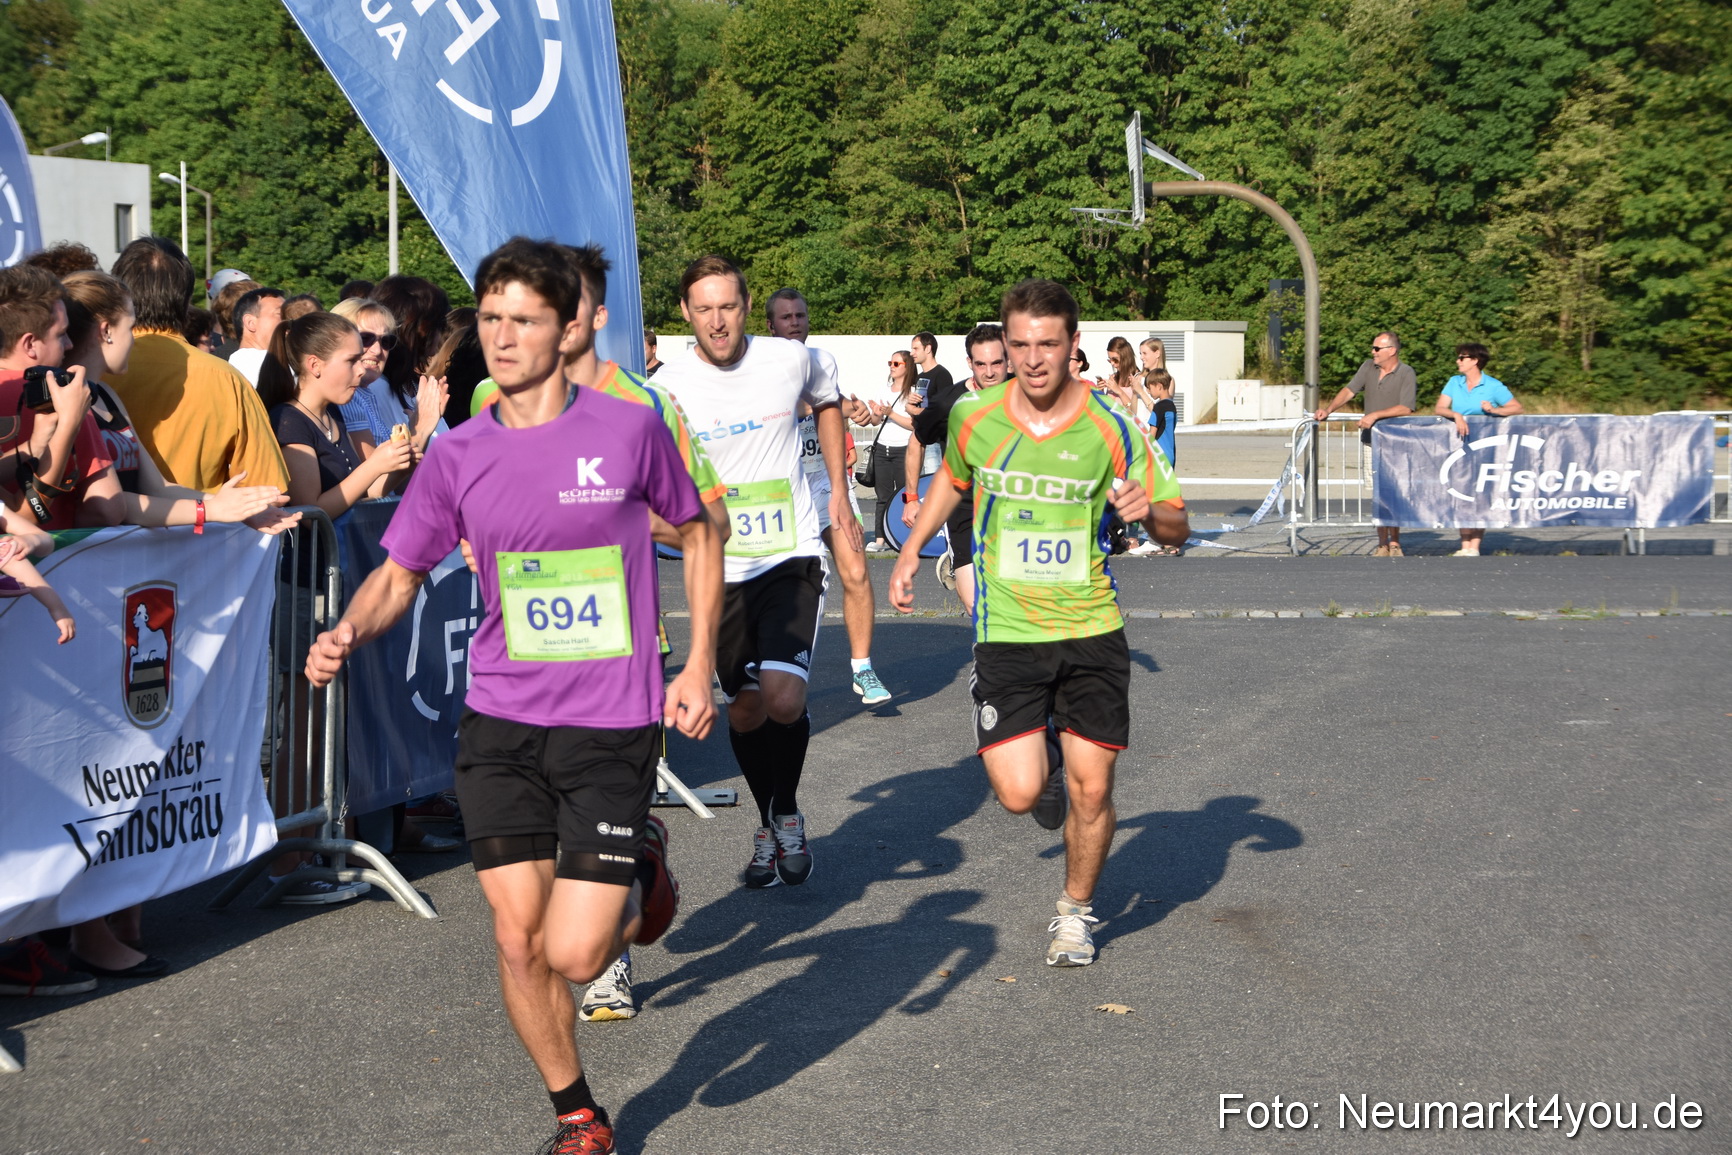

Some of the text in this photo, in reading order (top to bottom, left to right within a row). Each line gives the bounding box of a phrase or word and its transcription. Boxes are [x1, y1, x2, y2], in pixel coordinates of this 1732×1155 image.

[577, 457, 606, 486] K
[979, 467, 1096, 503] BOCK
[1476, 462, 1641, 493] Fischer
[559, 488, 625, 498] KÜFNER
[1490, 496, 1627, 510] AUTOMOBILE
[736, 509, 784, 537] 311
[1017, 538, 1072, 564] 150
[526, 594, 602, 631] 694
[135, 692, 160, 715] 1628
[611, 826, 633, 836] JAKO
